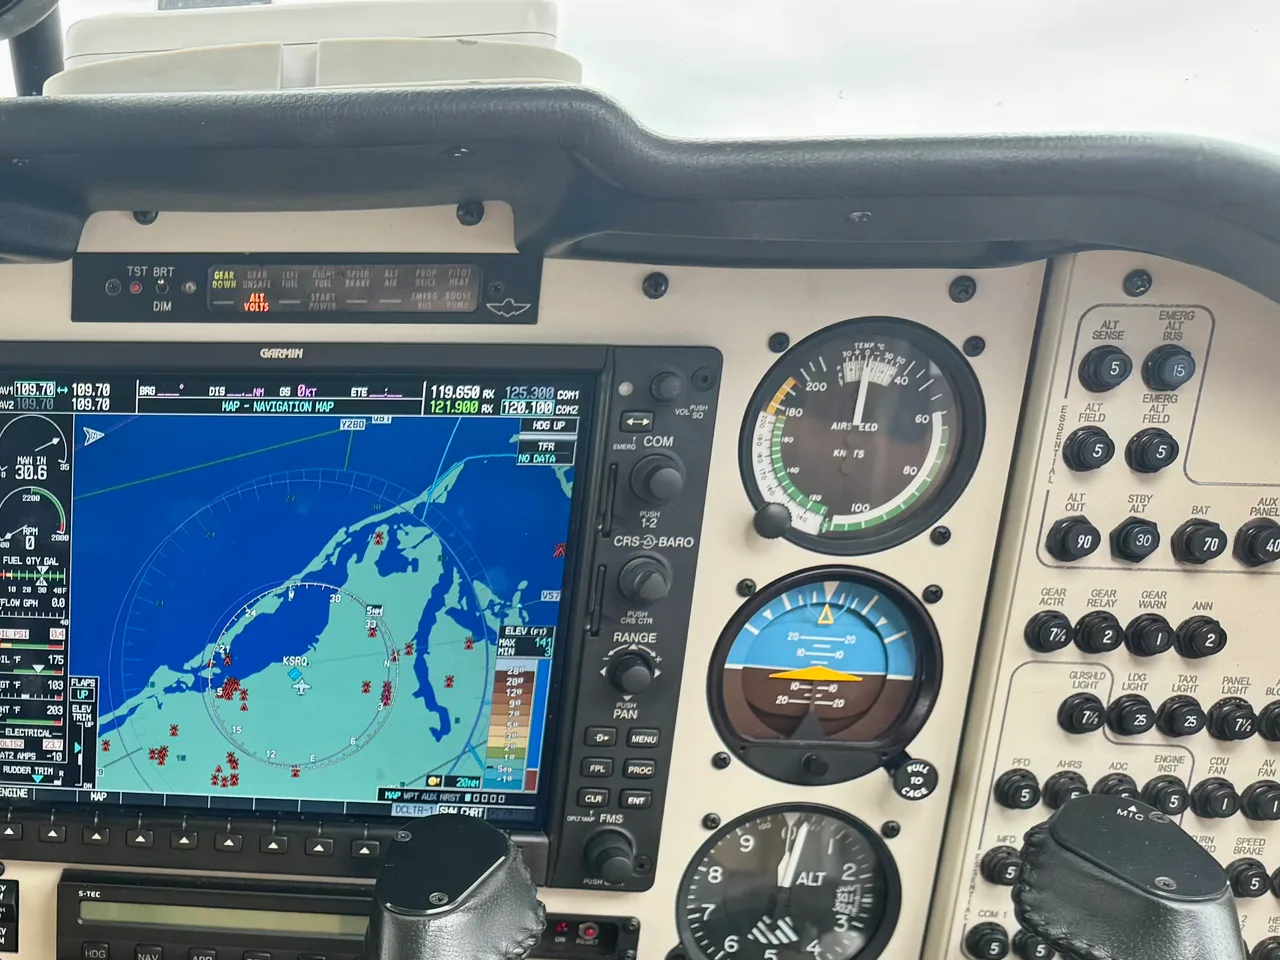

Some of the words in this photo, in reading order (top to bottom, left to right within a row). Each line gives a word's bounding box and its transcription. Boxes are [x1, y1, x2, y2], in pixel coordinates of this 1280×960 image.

[128, 266, 148, 276] TST
[153, 267, 174, 277] BRT
[214, 271, 234, 279] GEAR
[212, 280, 237, 288] DOWN
[249, 293, 264, 302] ALT
[153, 301, 172, 311] DIM
[244, 303, 269, 312] VOLTS
[1159, 311, 1195, 320] EMERG
[1100, 320, 1119, 329] ALT
[1165, 322, 1183, 330] ALT
[1092, 330, 1125, 340] SENSE
[1163, 331, 1183, 340] BUS
[260, 349, 303, 359] GARMIN
[894, 376, 908, 386] 40
[16, 384, 54, 396] 109.70
[72, 383, 110, 396] 109.70
[806, 382, 827, 391] 200
[431, 385, 480, 399] 119.650
[482, 389, 495, 399] RX
[506, 387, 554, 399] 125.300
[557, 390, 579, 400] COM1
[222, 401, 240, 412] MAP
[253, 401, 312, 413] NAVIGATION
[315, 402, 334, 413] MAP
[429, 401, 479, 414] 121.900
[503, 402, 553, 414] 120.100
[1084, 403, 1102, 412] ALT
[786, 408, 803, 416] 180
[915, 414, 930, 424] 60
[1078, 413, 1106, 422] FIELD
[643, 436, 673, 447] COM
[17, 456, 33, 465] MAN
[37, 456, 46, 465] IN
[15, 465, 47, 480] 30.6
[902, 466, 917, 476] 80
[1128, 494, 1153, 504] STBY
[851, 503, 870, 512] 100
[1191, 506, 1210, 515] BAT
[1077, 535, 1092, 548] 90
[1136, 534, 1152, 546] 30
[3, 557, 22, 565] FUEL
[26, 557, 42, 566] QTY
[44, 558, 58, 566] GAL
[1087, 598, 1117, 607] RELAY
[1139, 600, 1167, 609] WARN
[1192, 602, 1213, 610] ANN
[282, 656, 307, 667] KSRQ
[71, 678, 96, 687] FLAPS
[1178, 675, 1198, 684] TAXI
[1122, 682, 1149, 691] LIGHT
[77, 690, 88, 699] UP
[1134, 714, 1147, 726] 25
[5, 728, 52, 737] ELECTRICAL
[1154, 755, 1186, 764] ENGINE
[1210, 757, 1229, 766] CDU
[906, 764, 930, 774] PULL
[1208, 766, 1227, 775] FAN
[910, 776, 923, 785] TO
[902, 786, 928, 798] CAGE
[740, 836, 754, 852] 9
[1236, 837, 1266, 847] SPEED
[1233, 846, 1264, 855] BRAKE
[842, 864, 856, 880] 2
[796, 872, 826, 886] ALT
